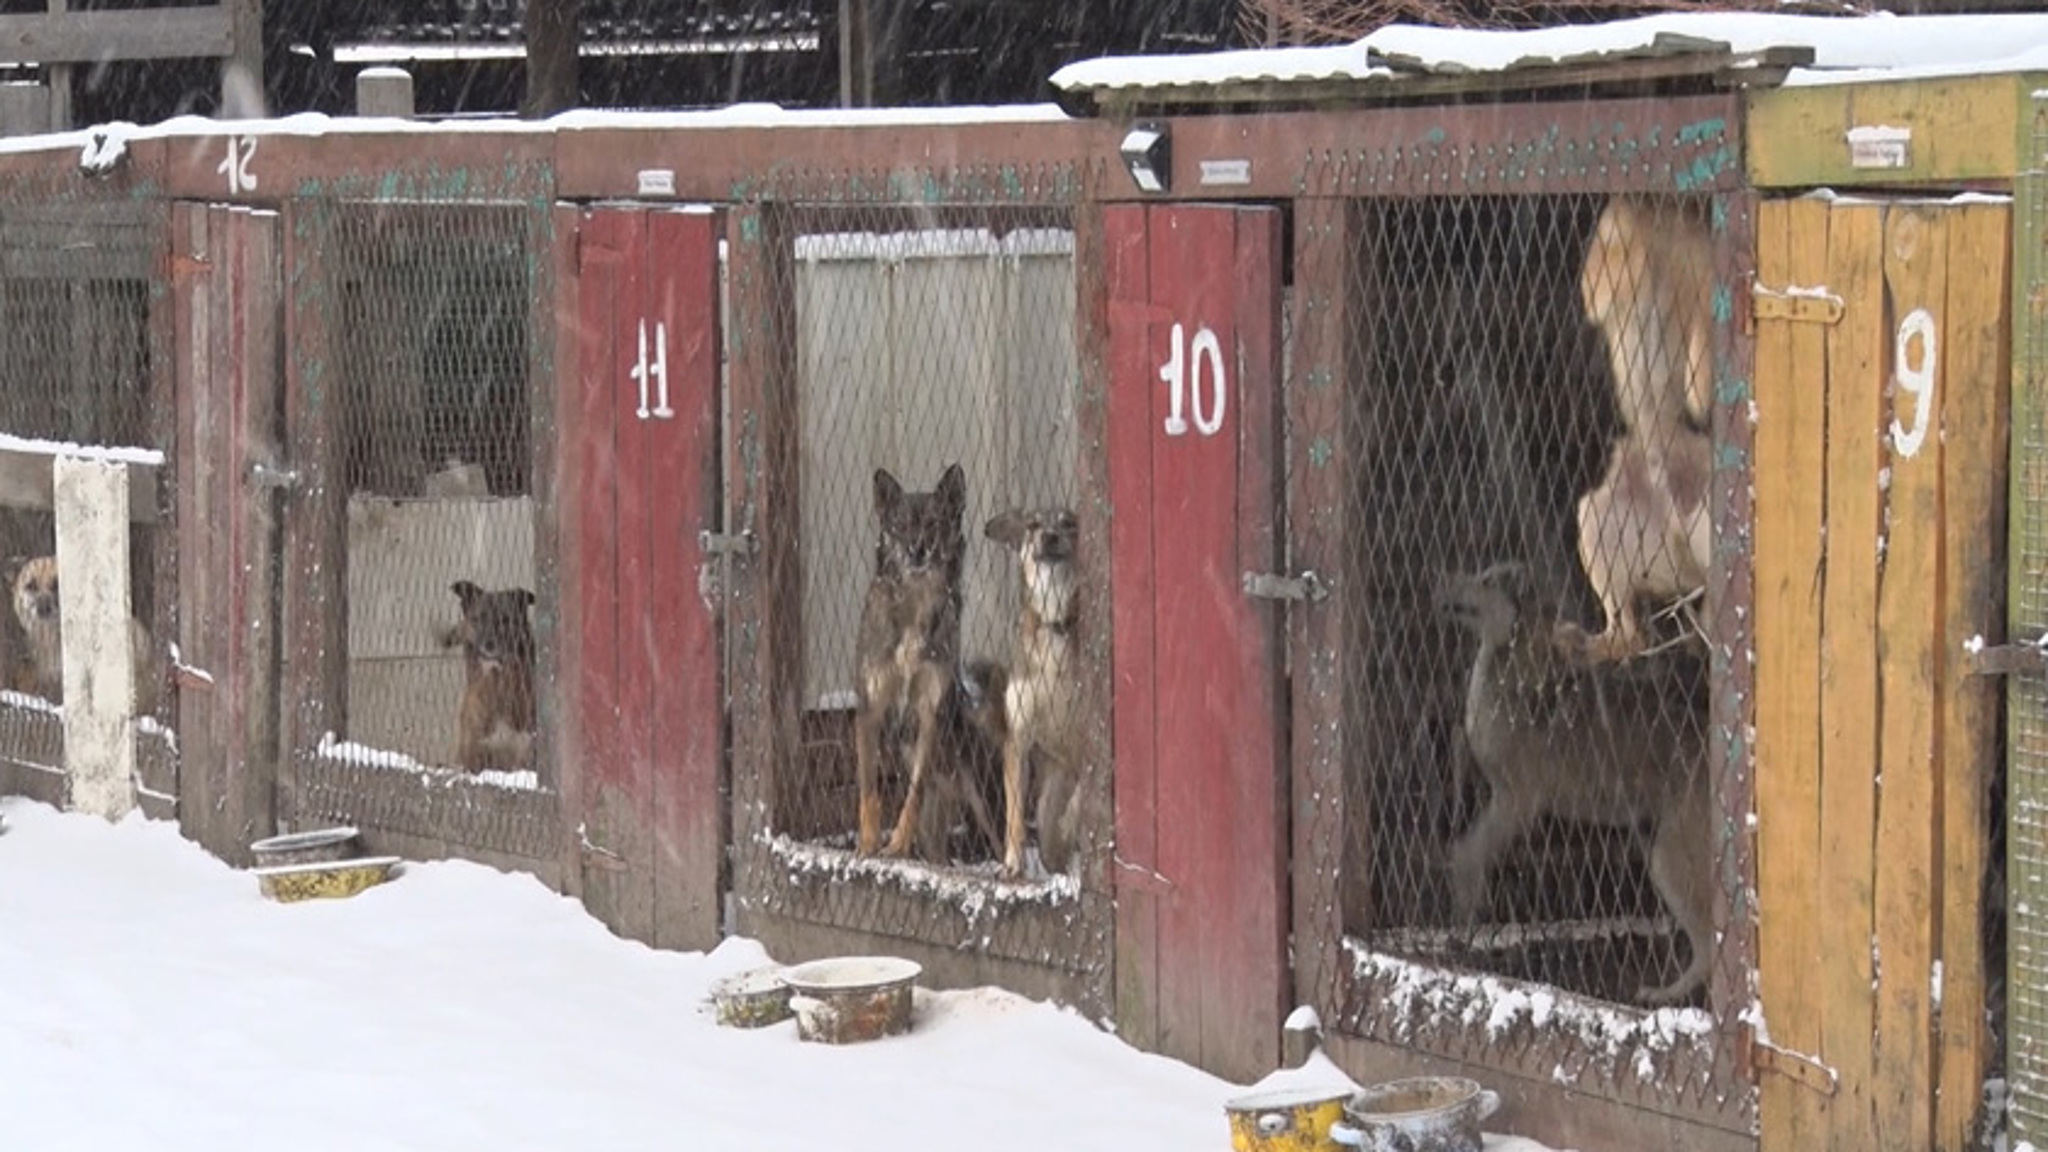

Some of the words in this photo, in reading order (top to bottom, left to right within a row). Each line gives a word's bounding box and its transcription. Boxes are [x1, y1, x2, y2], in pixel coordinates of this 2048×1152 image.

[217, 134, 257, 194] 12
[630, 317, 674, 419] 11
[1160, 323, 1226, 435] 10
[1890, 308, 1936, 461] 9
